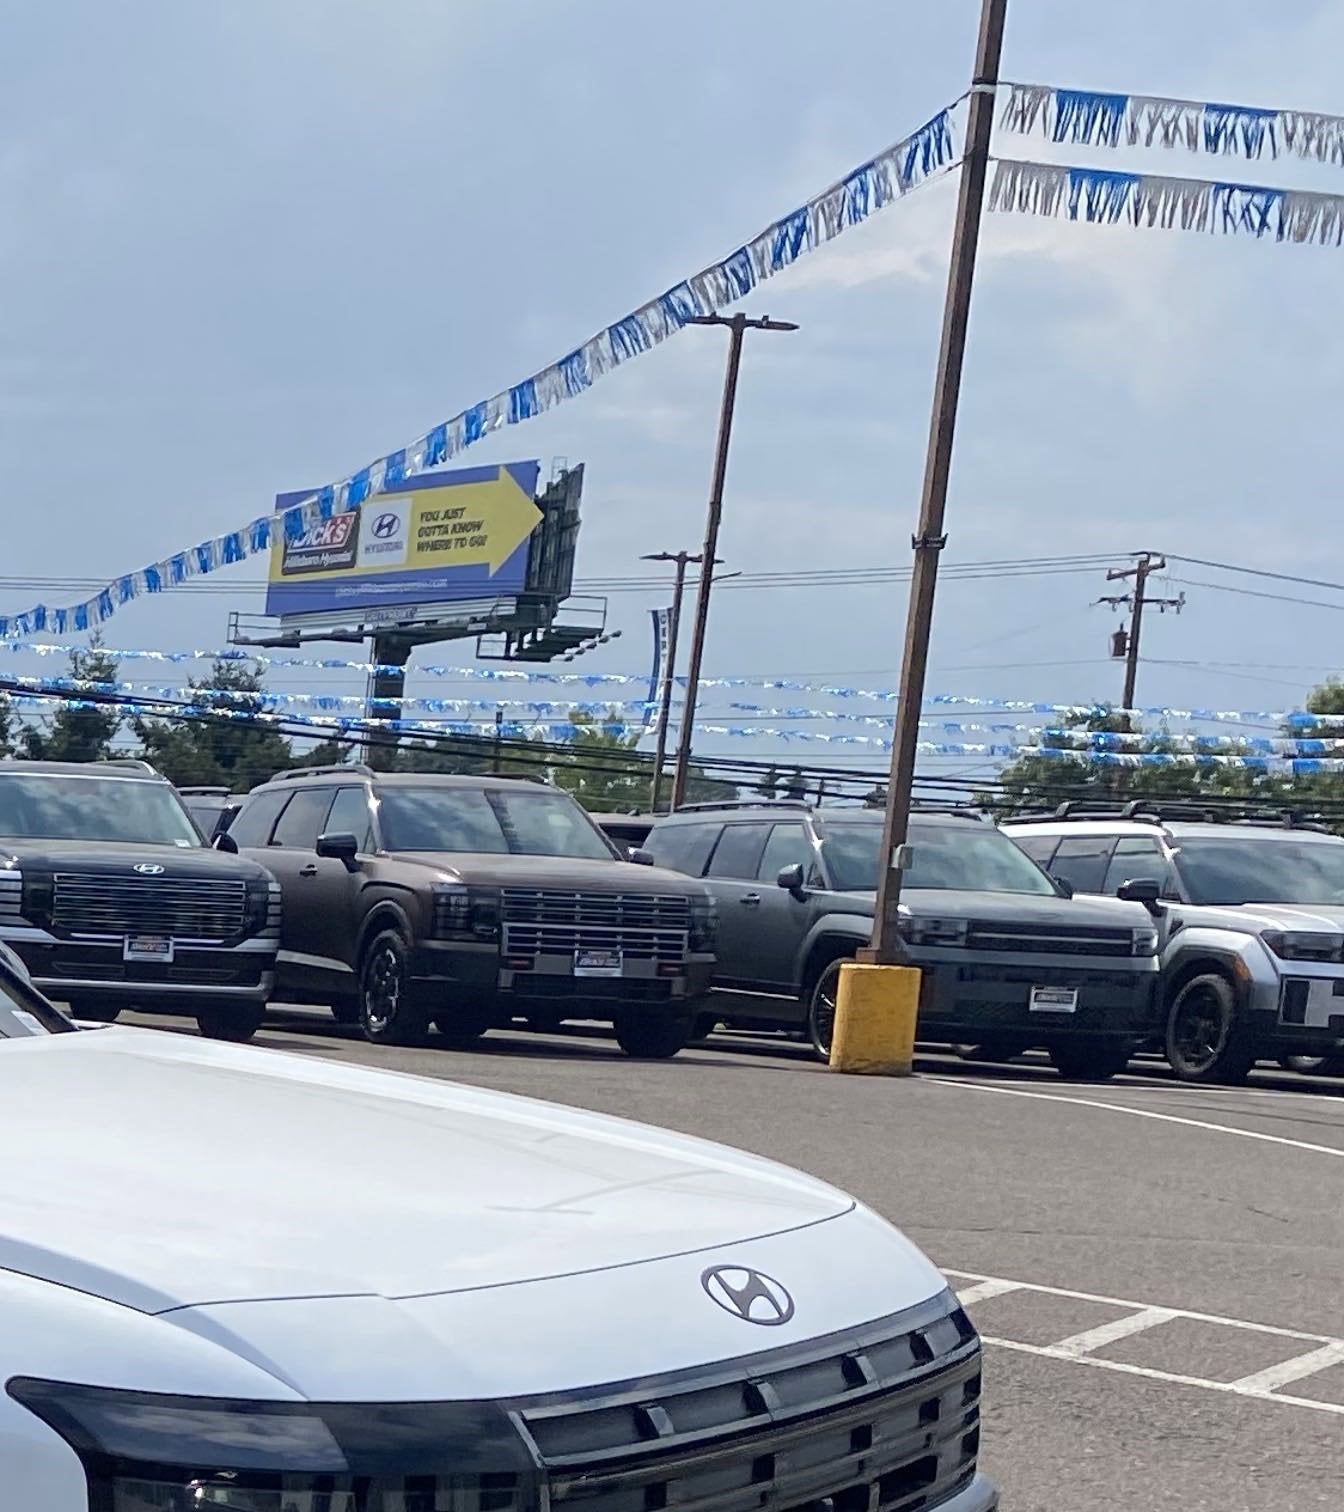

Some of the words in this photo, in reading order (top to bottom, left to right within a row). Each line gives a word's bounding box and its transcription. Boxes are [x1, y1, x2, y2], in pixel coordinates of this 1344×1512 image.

[420, 510, 441, 522] YOU
[441, 507, 466, 521] JUST
[418, 524, 449, 538] GOTTA
[451, 520, 484, 535] KNOW
[417, 539, 452, 553] WHERE
[454, 537, 468, 550] TO
